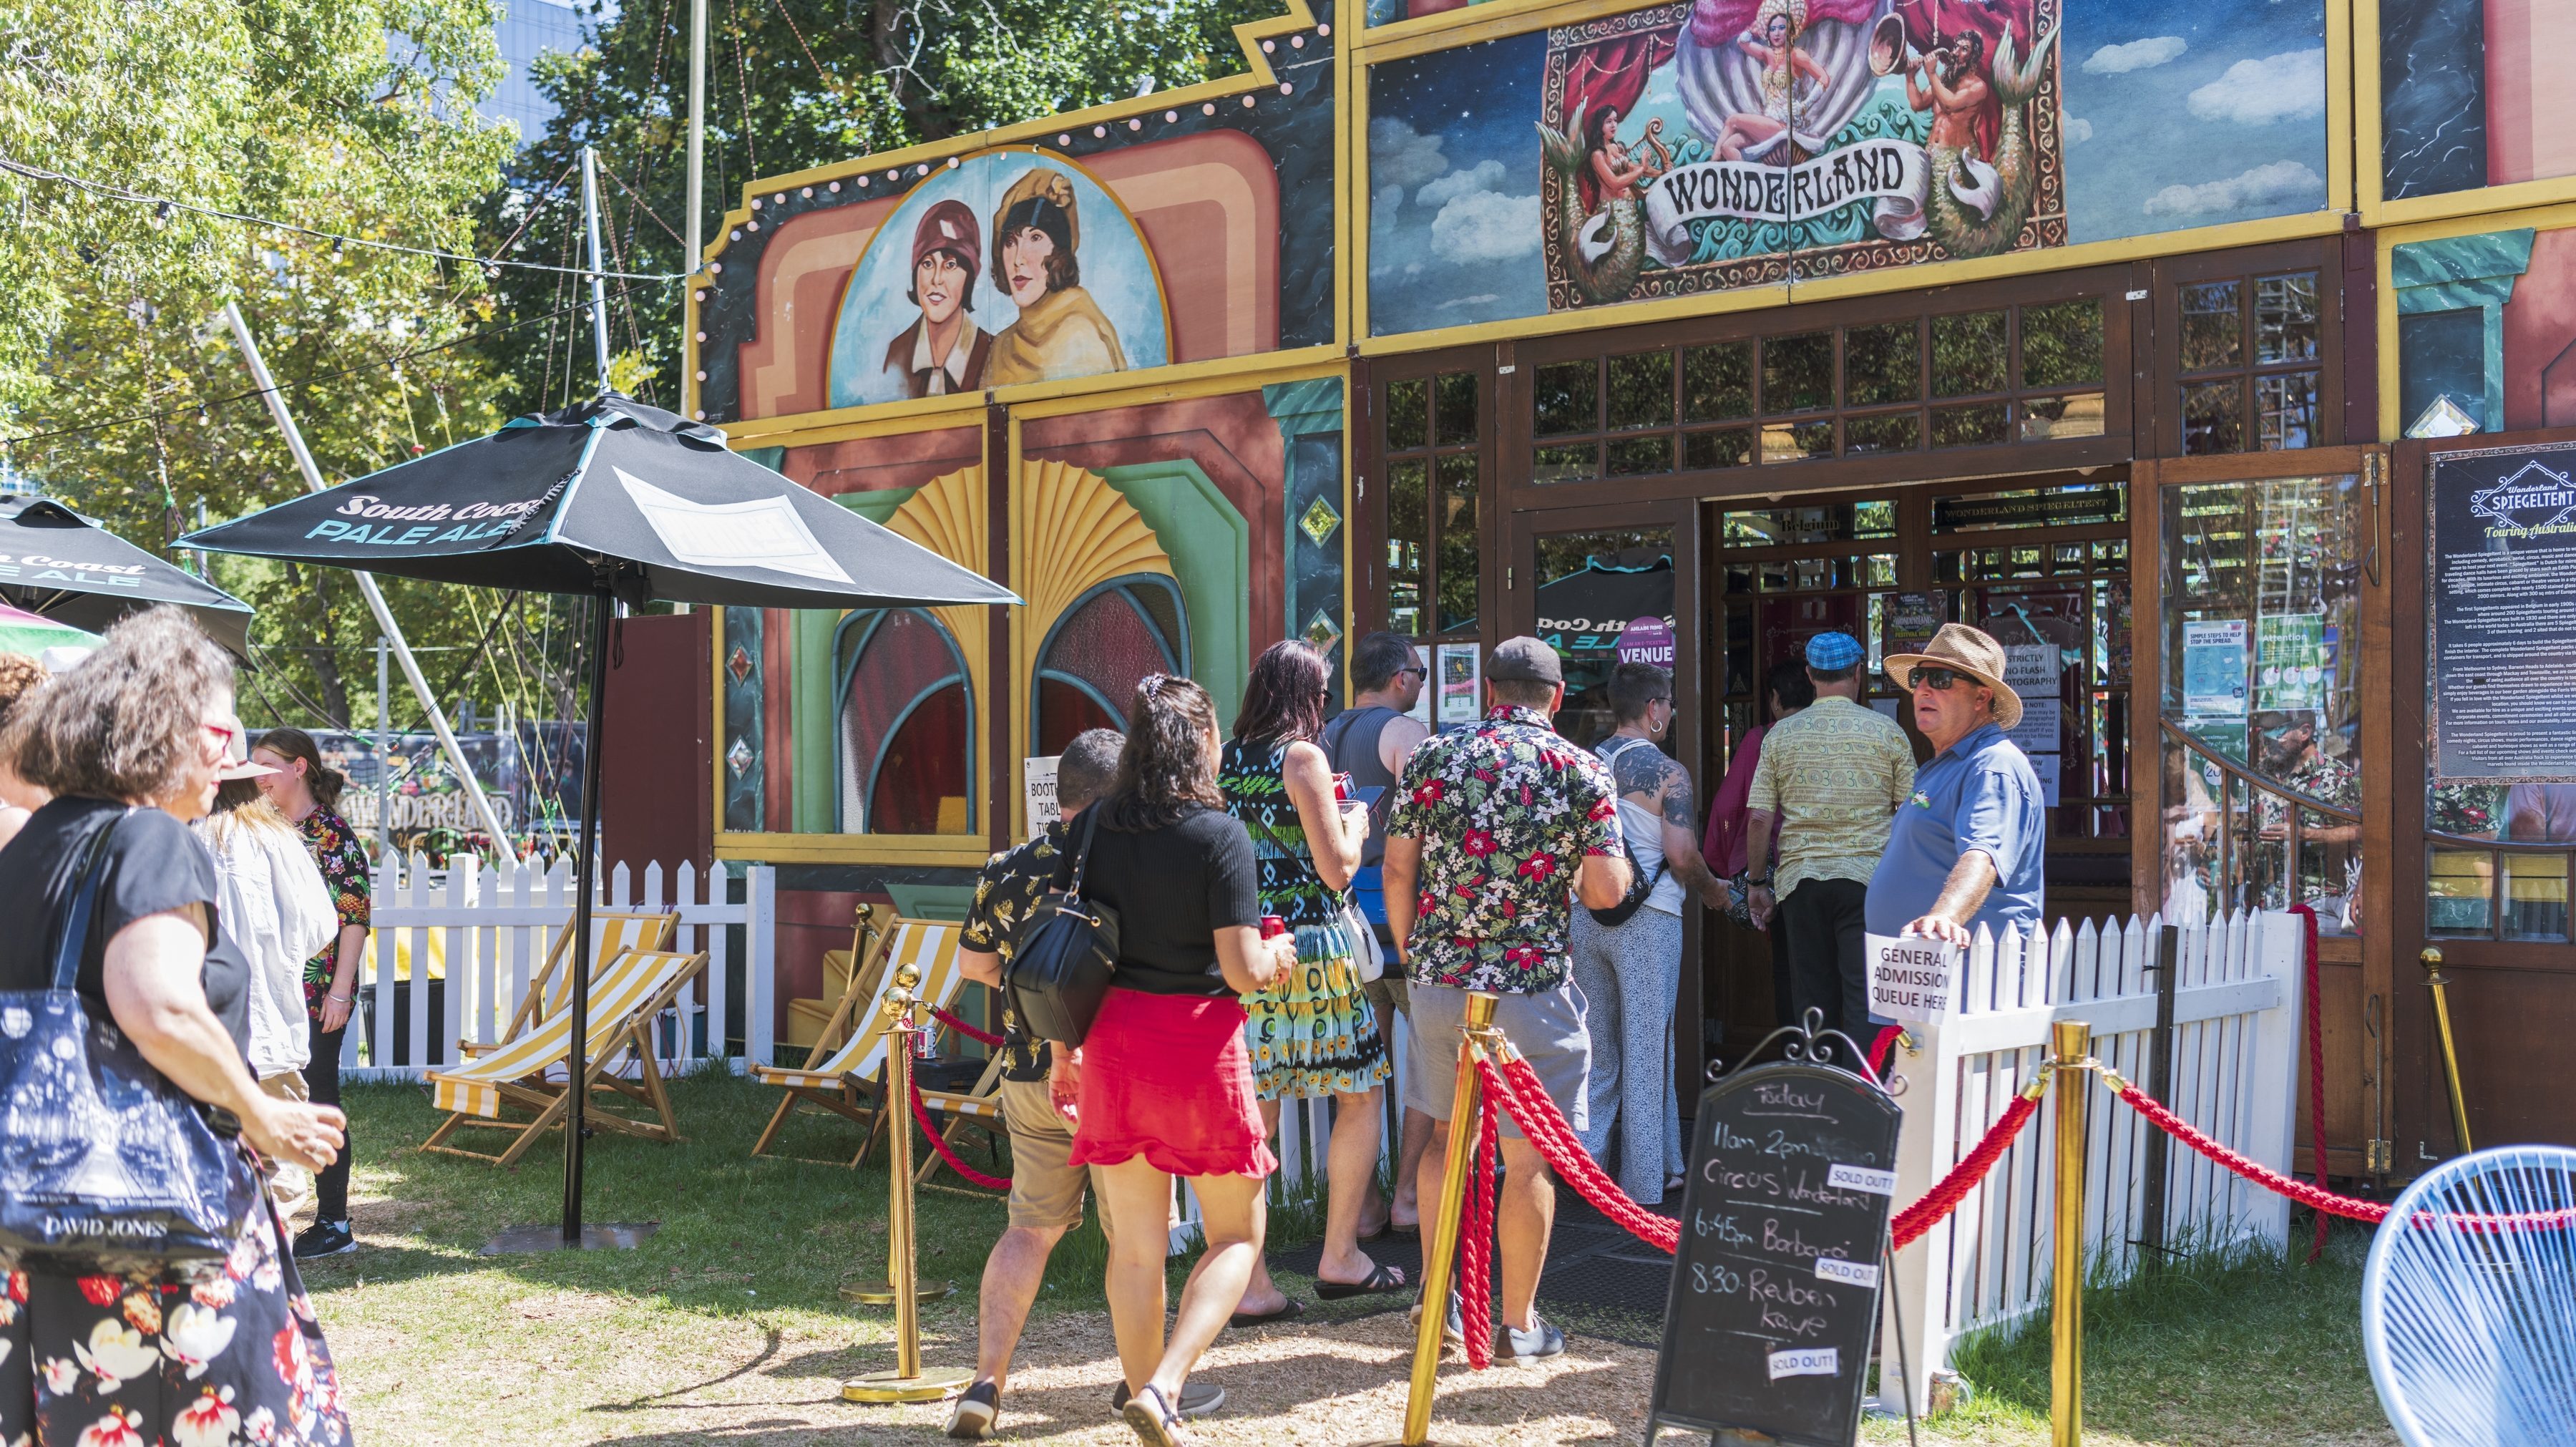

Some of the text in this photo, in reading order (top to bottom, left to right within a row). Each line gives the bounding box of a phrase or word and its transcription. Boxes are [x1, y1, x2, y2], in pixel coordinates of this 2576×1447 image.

[1664, 147, 1904, 215] WONDERLAND
[2507, 483, 2558, 494] Wonderland
[336, 495, 542, 521] South Coas
[1945, 498, 2109, 518] WONDERLAND SPIEGELTENT
[2492, 491, 2575, 510] SPIEGELTENT
[305, 520, 514, 545] PALE ALE
[1781, 518, 1840, 532] Belgium
[2484, 526, 2528, 539] Touring
[21, 555, 146, 575] Coast
[31, 570, 141, 587] ALE
[2263, 633, 2307, 642] Attention
[1620, 647, 1673, 663] VENUE
[2007, 654, 2044, 663] STRICTLY
[2021, 666, 2045, 675] FLASH
[2004, 677, 2057, 686] OTOGRAPHY
[2206, 766, 2221, 777] 20
[1038, 802, 1061, 816] TABL
[1881, 947, 1947, 968] GENERAL
[1874, 966, 1950, 988] ADMISSION
[1873, 987, 1947, 1010] QUEUE HERE
[1754, 1084, 1825, 1114] Today
[1704, 1159, 1781, 1195] Circus
[1833, 1171, 1893, 1189] SOLD OUT!
[45, 1215, 168, 1237] DAVID JONES
[1820, 1263, 1850, 1278] SOLD
[1772, 1355, 1834, 1372] SOLD OUT!
